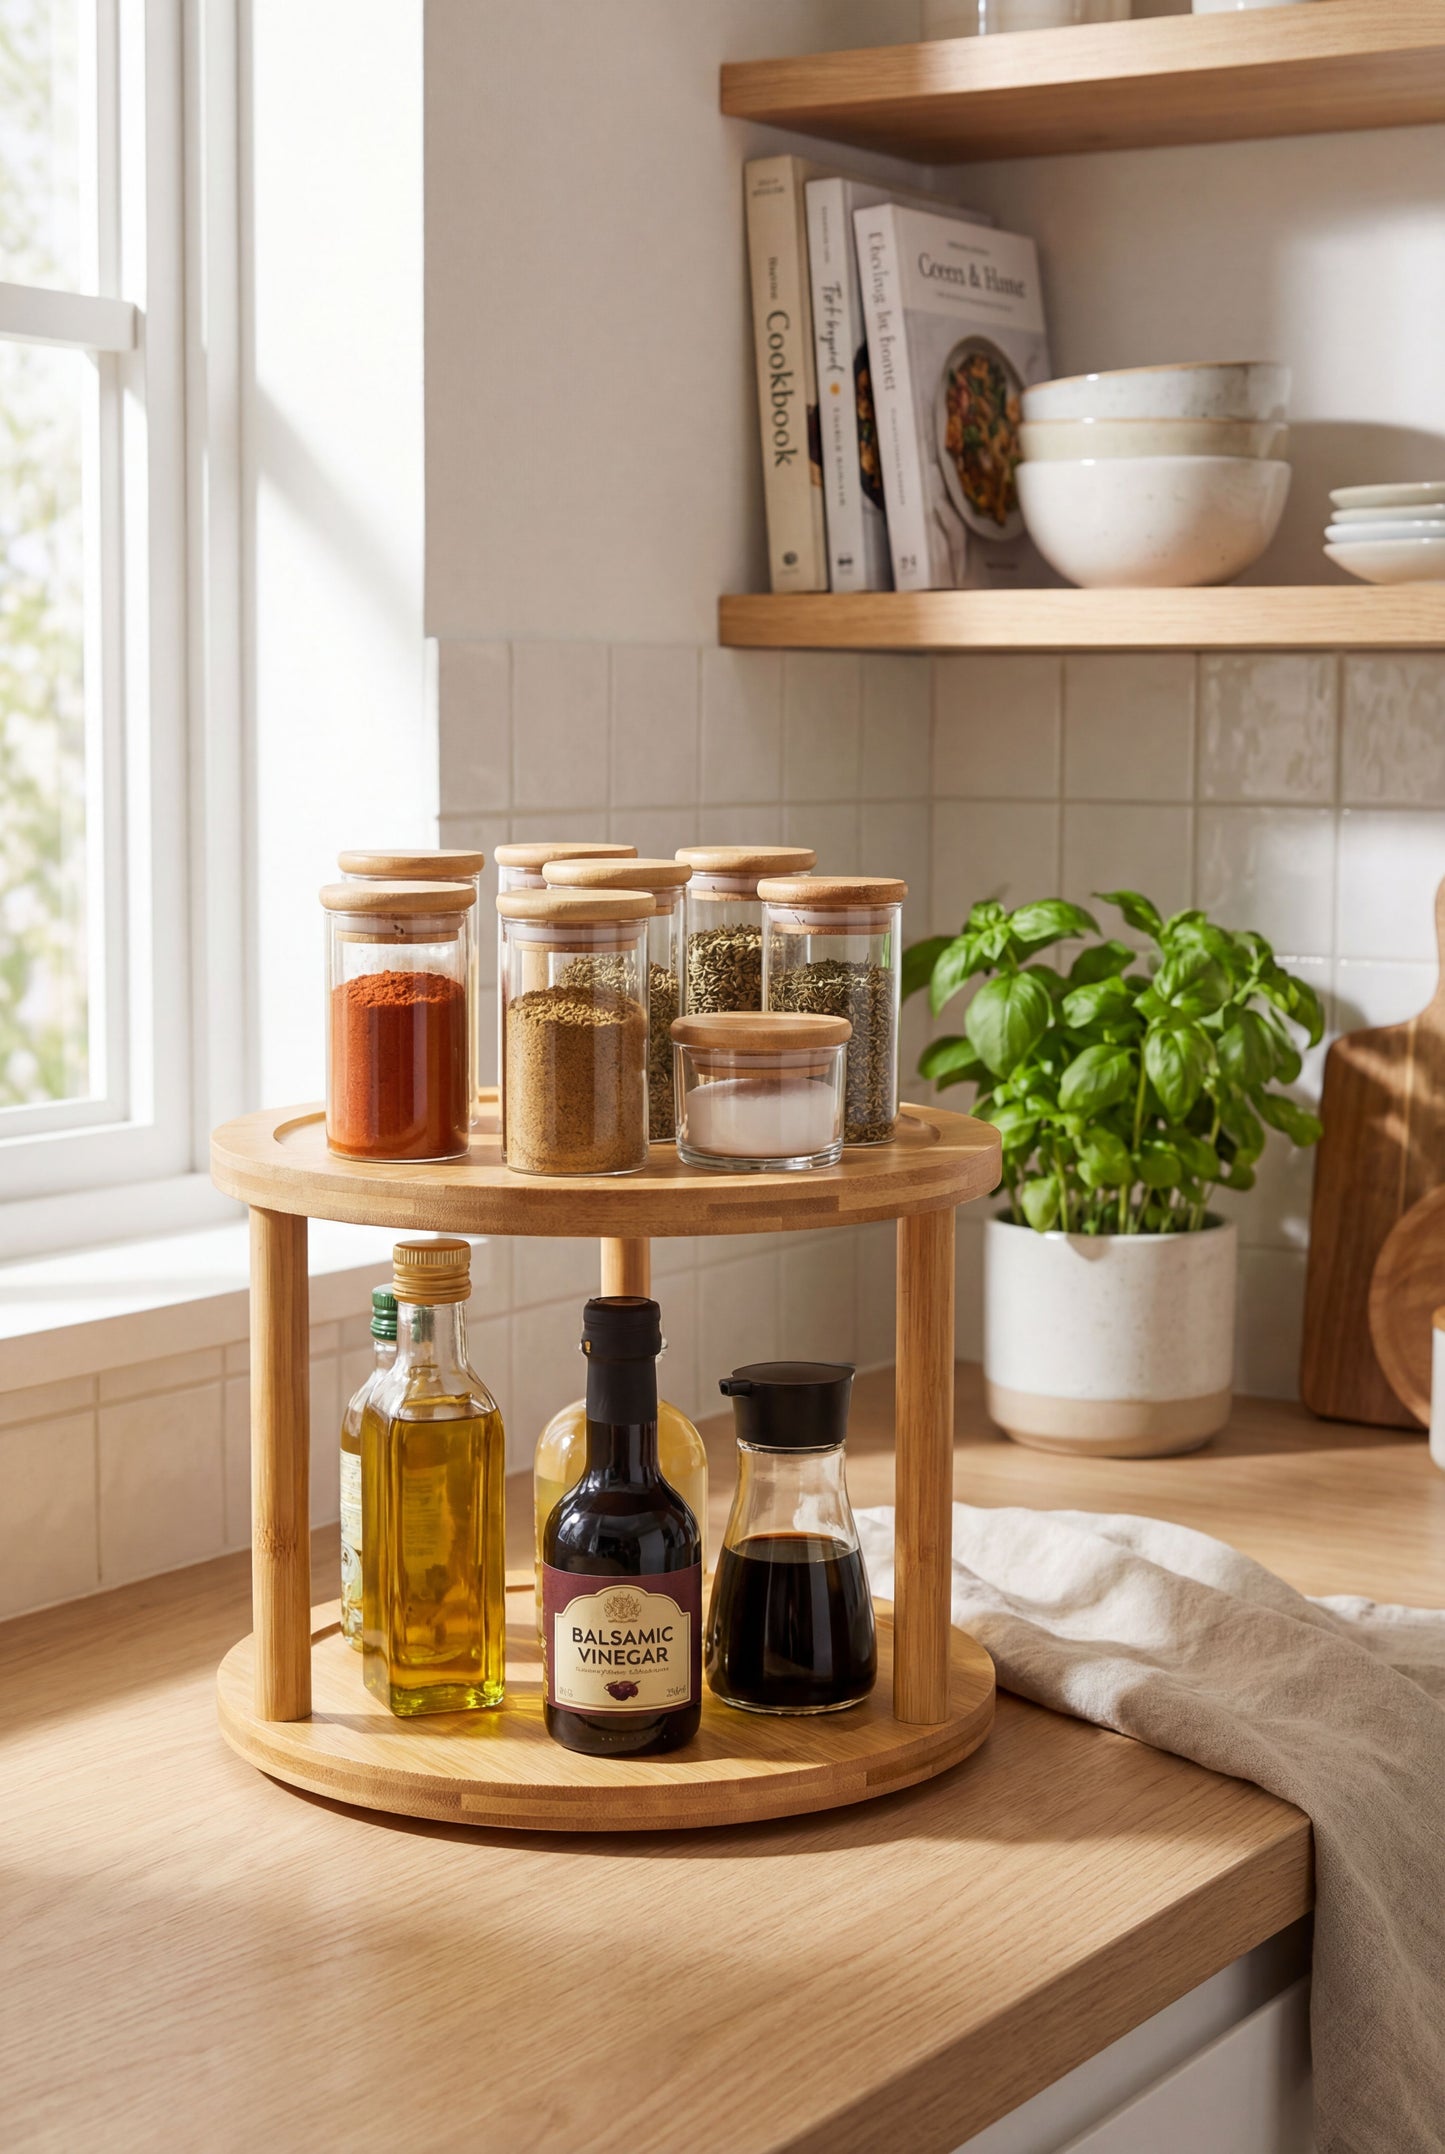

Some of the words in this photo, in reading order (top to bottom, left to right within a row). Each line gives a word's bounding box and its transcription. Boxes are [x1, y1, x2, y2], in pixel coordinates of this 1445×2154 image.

[766, 310, 798, 468] Cookbook
[572, 1626, 673, 1646] BALSAMIC
[577, 1647, 669, 1665] VINEGAR
